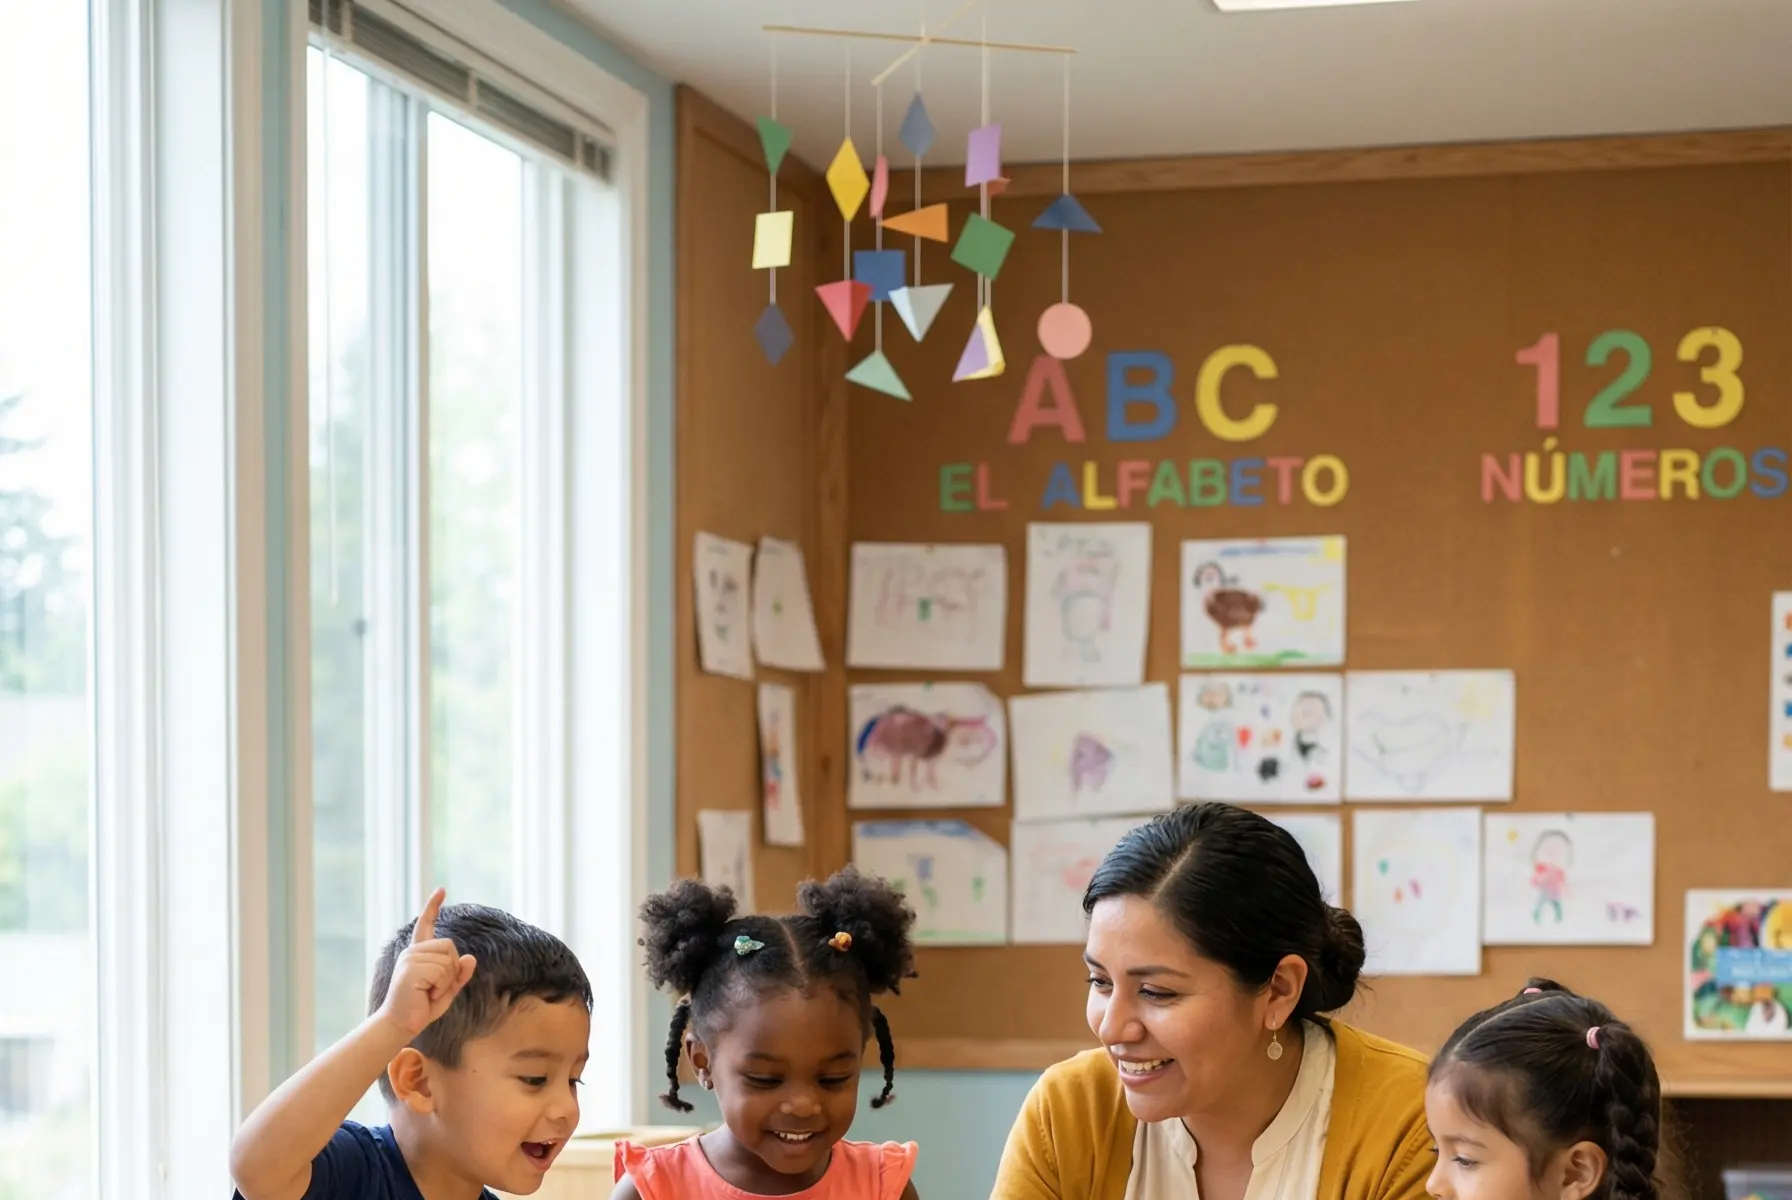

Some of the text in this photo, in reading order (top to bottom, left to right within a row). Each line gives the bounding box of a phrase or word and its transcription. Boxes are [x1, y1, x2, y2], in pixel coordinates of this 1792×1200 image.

[938, 453, 1350, 512] EL ALFABETO
[1481, 436, 1788, 504] NÚMEROS
